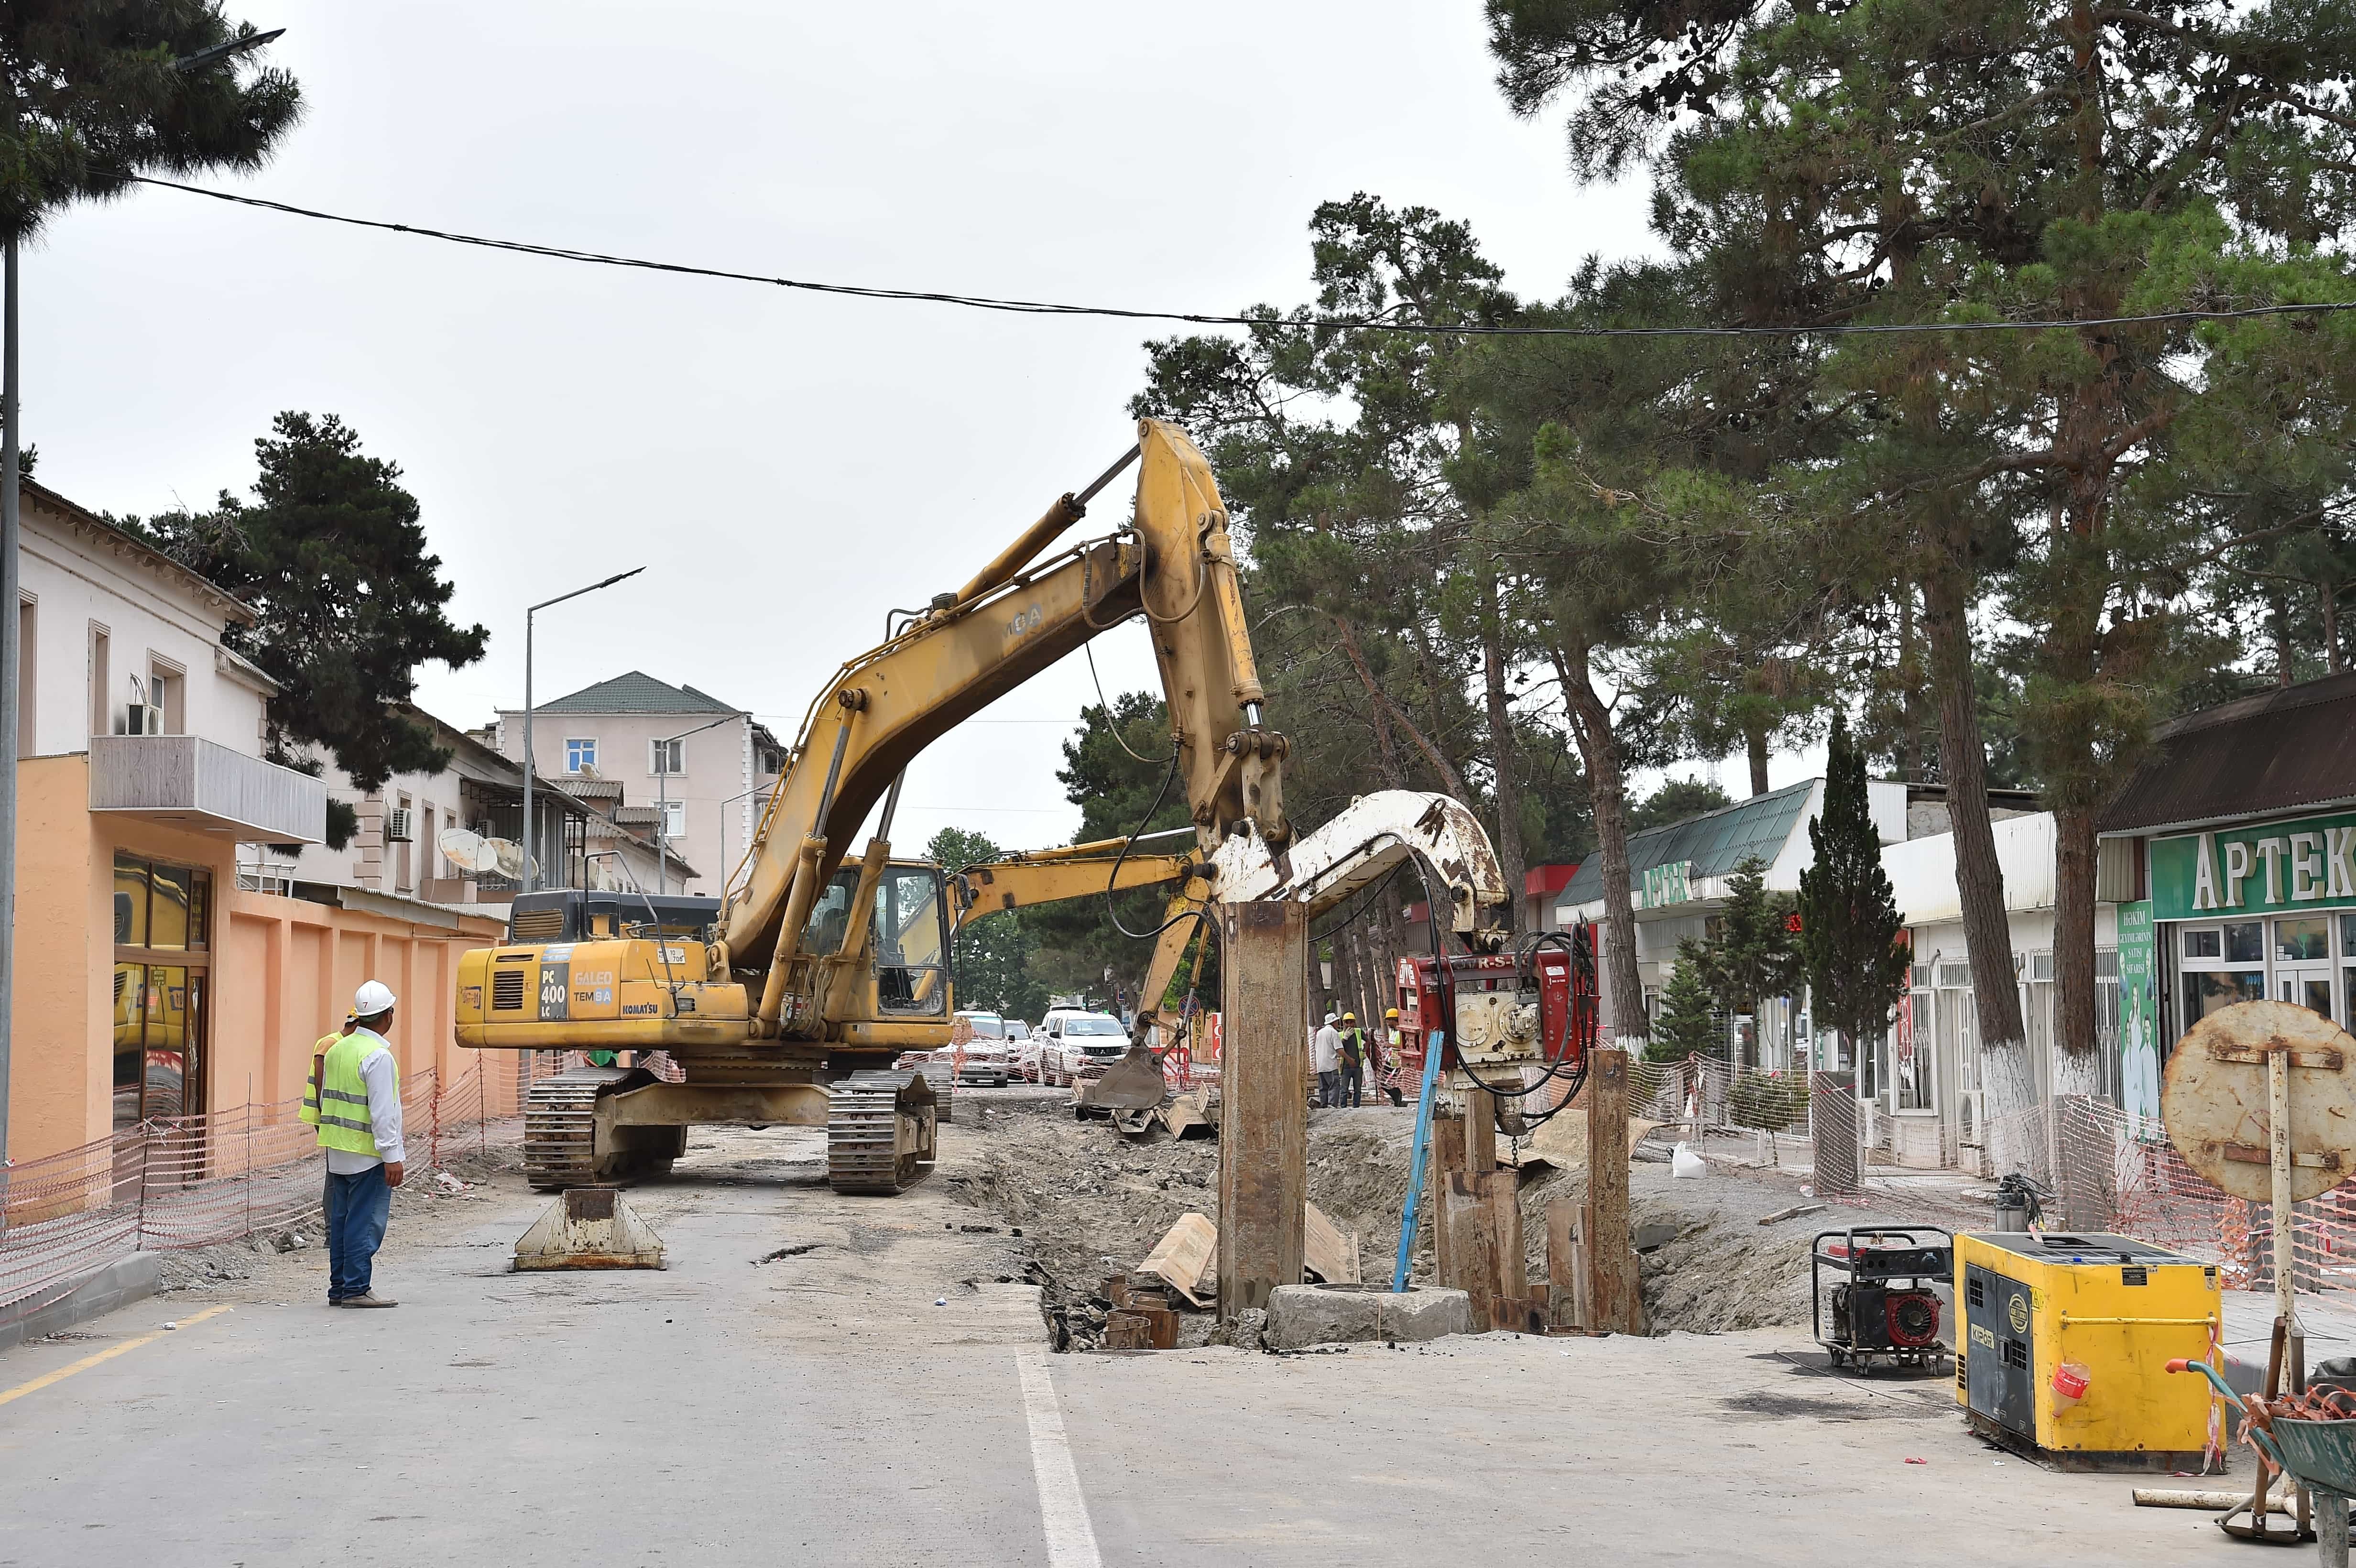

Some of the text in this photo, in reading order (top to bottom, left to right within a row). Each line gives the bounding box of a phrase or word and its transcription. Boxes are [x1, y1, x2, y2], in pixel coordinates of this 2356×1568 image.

[2192, 827, 2356, 910] APTEK
[1642, 860, 1693, 909] APTEK
[2124, 908, 2145, 926] HƏKİM
[2118, 929, 2152, 944] GEYİMLƏRİNİN
[542, 969, 555, 984] PC
[575, 971, 612, 986] GALEO
[541, 985, 565, 1003] 400
[574, 990, 612, 1002] TEMSA
[541, 1006, 550, 1017] LC
[622, 1002, 658, 1014] KOMATSU
[1973, 1328, 1993, 1348] KIPOR
